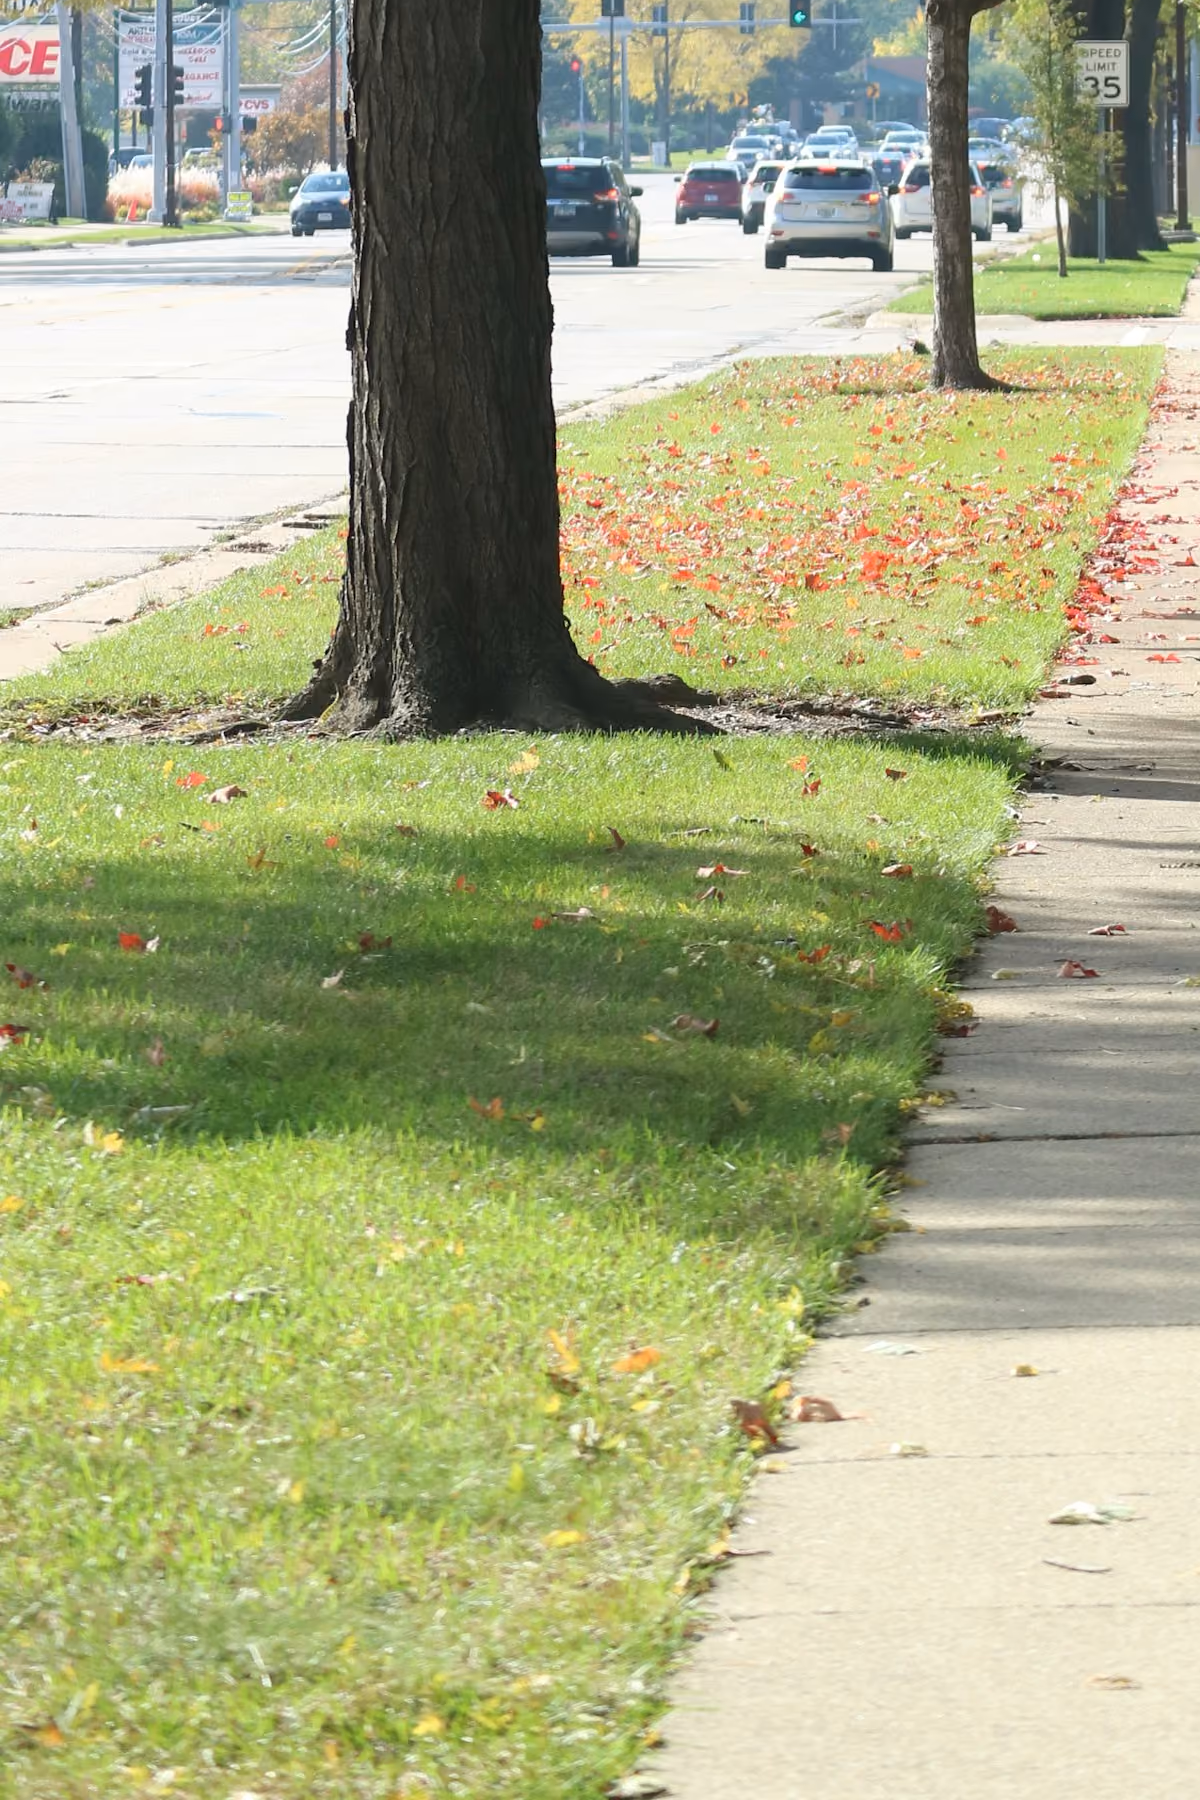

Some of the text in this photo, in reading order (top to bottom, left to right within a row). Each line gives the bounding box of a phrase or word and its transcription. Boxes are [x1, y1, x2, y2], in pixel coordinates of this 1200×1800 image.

[1086, 62, 1117, 72] LIMIT
[1084, 76, 1121, 99] 35
[244, 99, 270, 110] CVS
